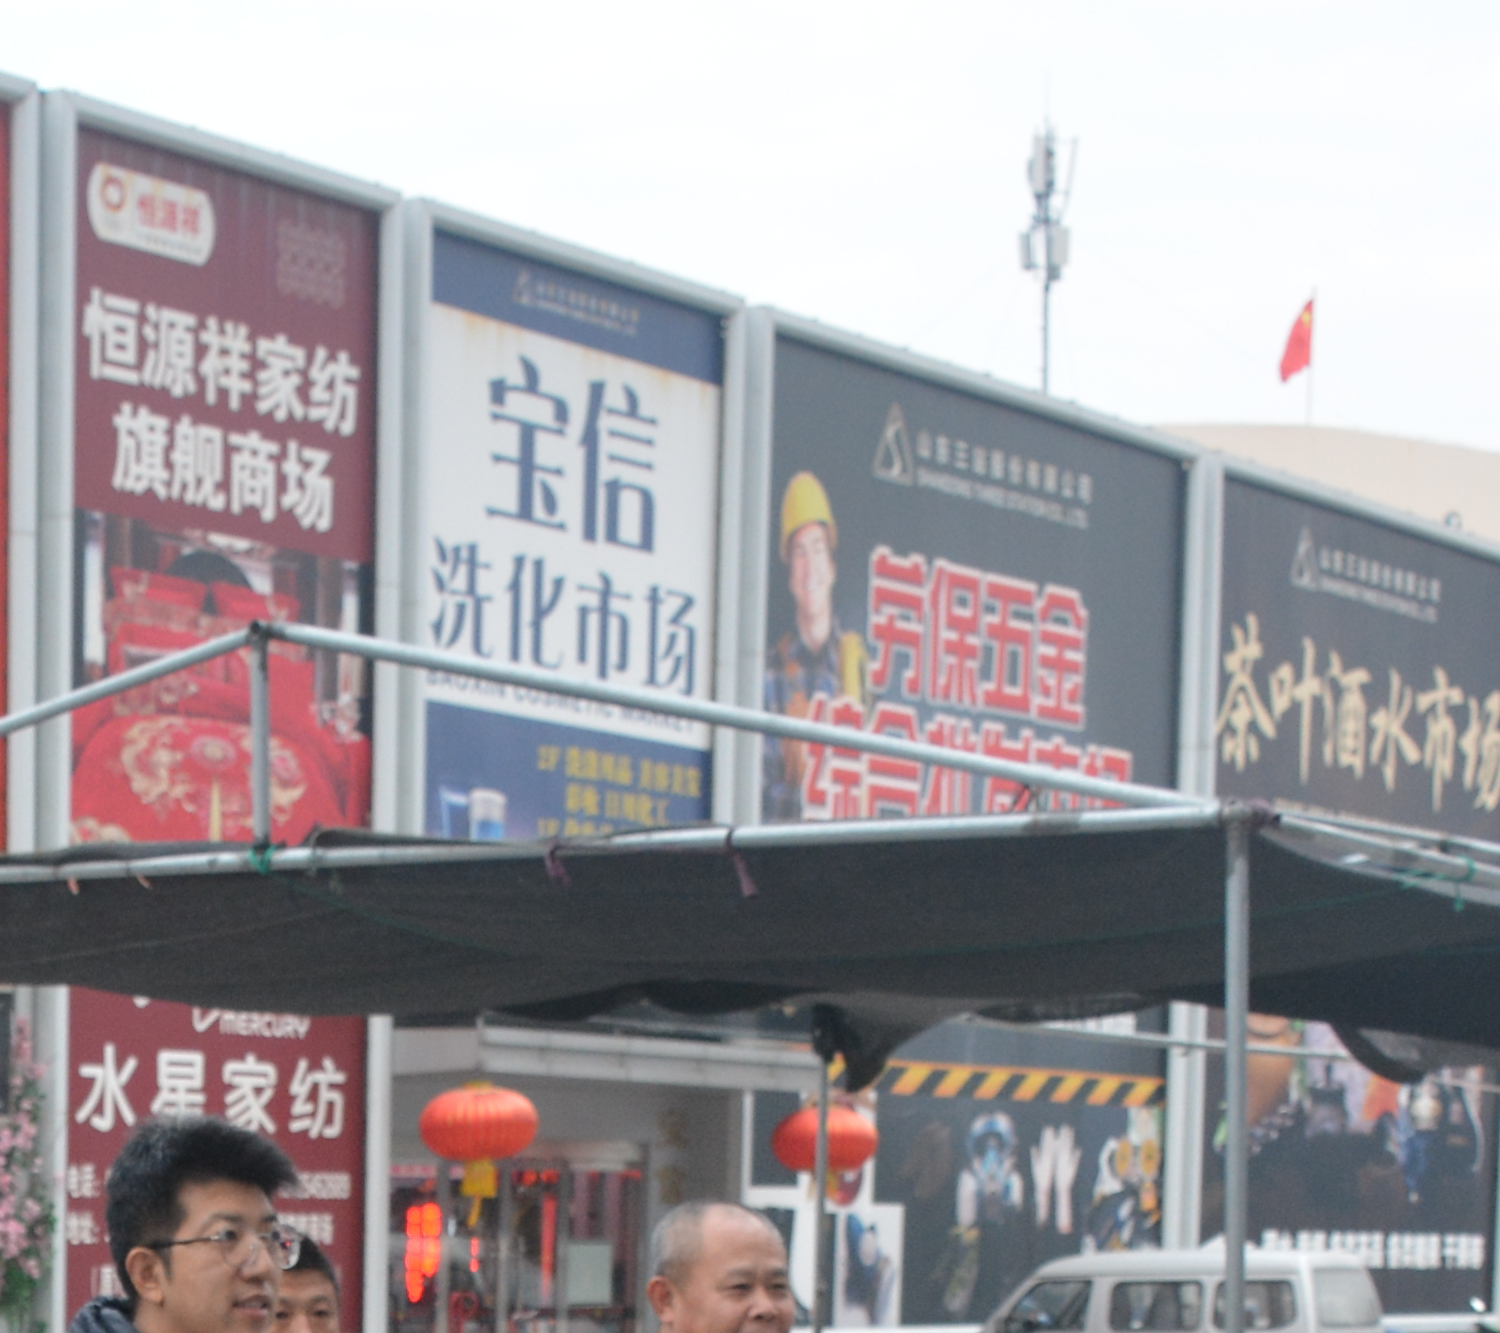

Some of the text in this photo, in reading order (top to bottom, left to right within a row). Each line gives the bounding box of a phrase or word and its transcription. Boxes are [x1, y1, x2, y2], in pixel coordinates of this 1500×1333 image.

[110, 400, 336, 532] 旗舰商场
[486, 352, 660, 555] 宝信
[429, 534, 698, 698] 洗化市场
[867, 544, 1090, 732] 劳保五金
[74, 1042, 348, 1140] 水星家纺
[219, 1010, 312, 1039] MERCURY
